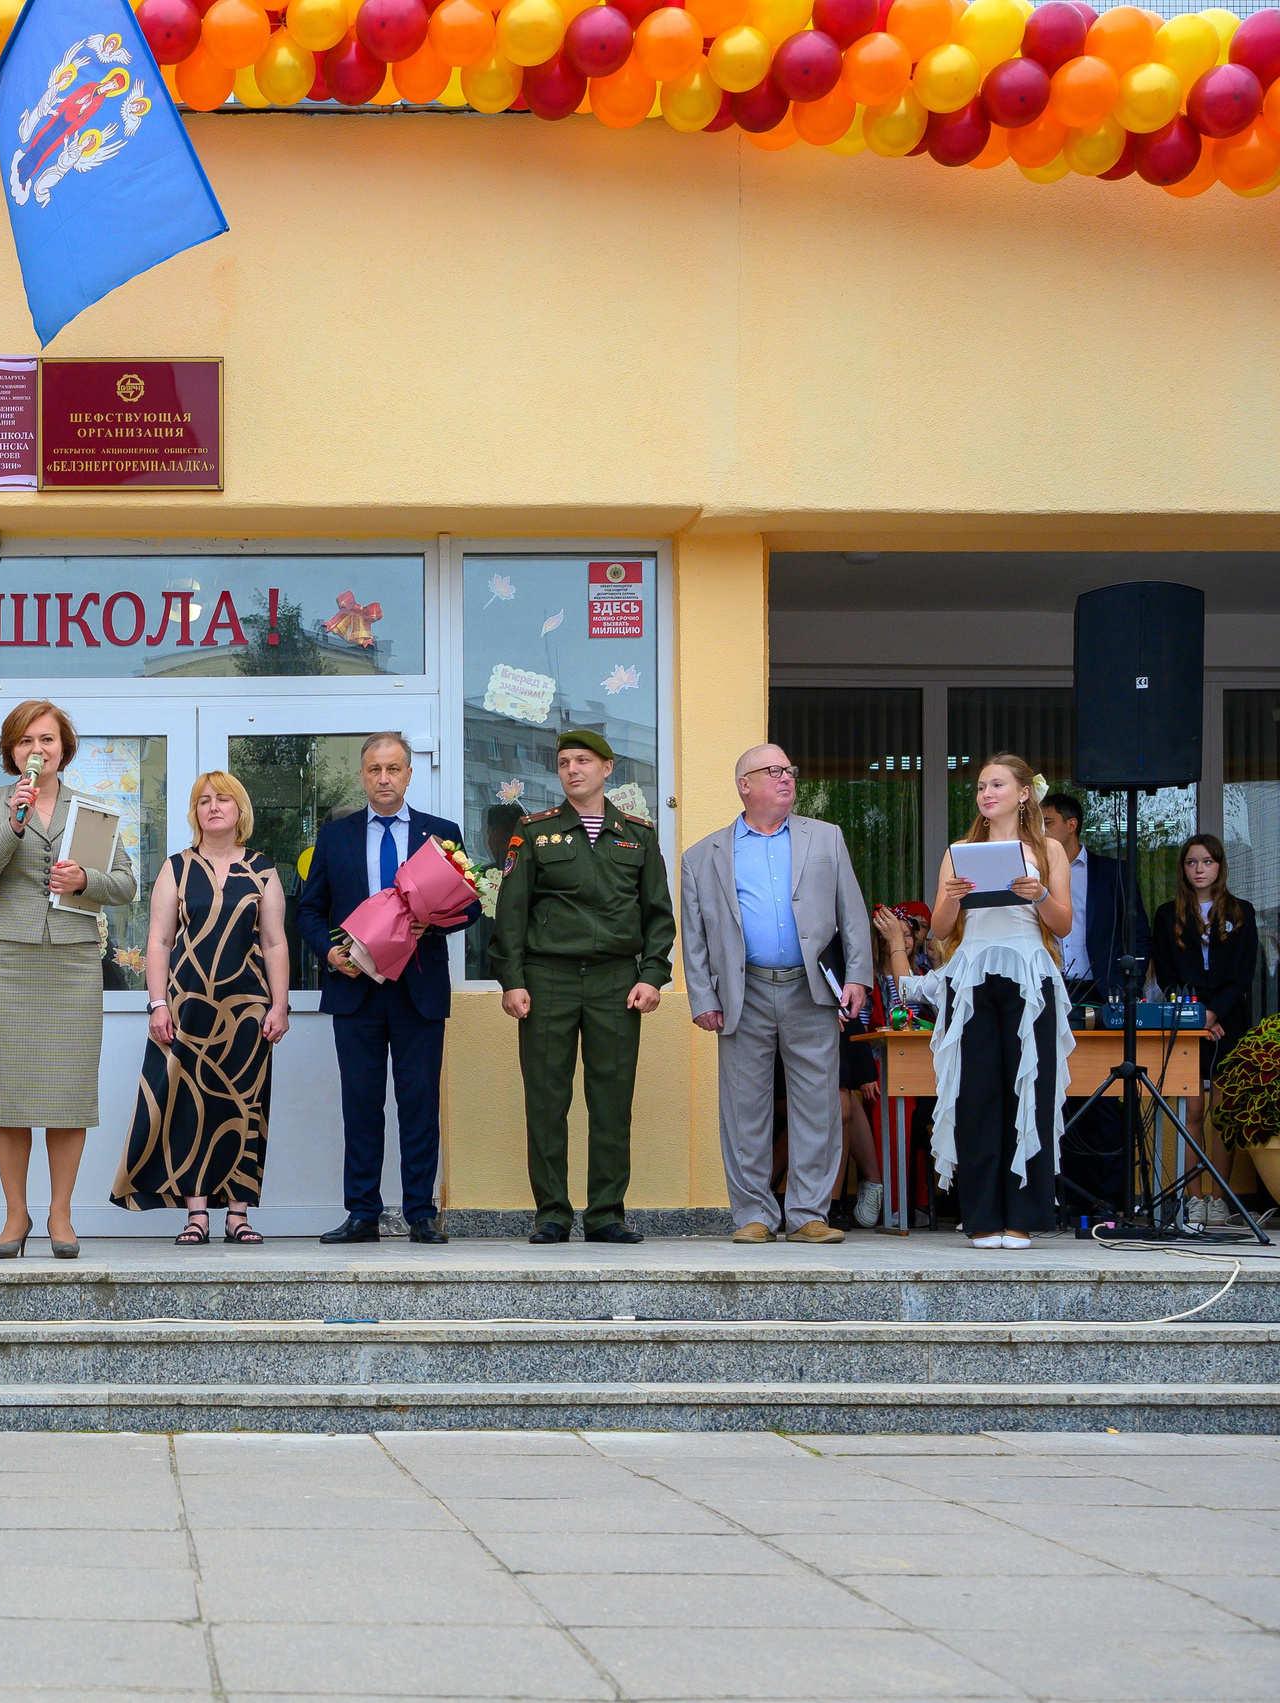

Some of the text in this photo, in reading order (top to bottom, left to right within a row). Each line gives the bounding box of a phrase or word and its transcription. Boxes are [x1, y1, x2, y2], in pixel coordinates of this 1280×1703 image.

[70, 412, 192, 424] ШЕФСТВУЮЩАЯ
[77, 428, 184, 439] ОРГАНИЗАЦИЯ
[46, 460, 215, 473] «БЕЛЭНЕРГОРЕМНАЛАДКА»
[593, 602, 640, 616] ЗДЕСЬ
[592, 627, 640, 635] МИЛИЦИЮ
[501, 668, 540, 688] Вперёд
[499, 682, 545, 700] знаниям!
[610, 791, 627, 802] ова
